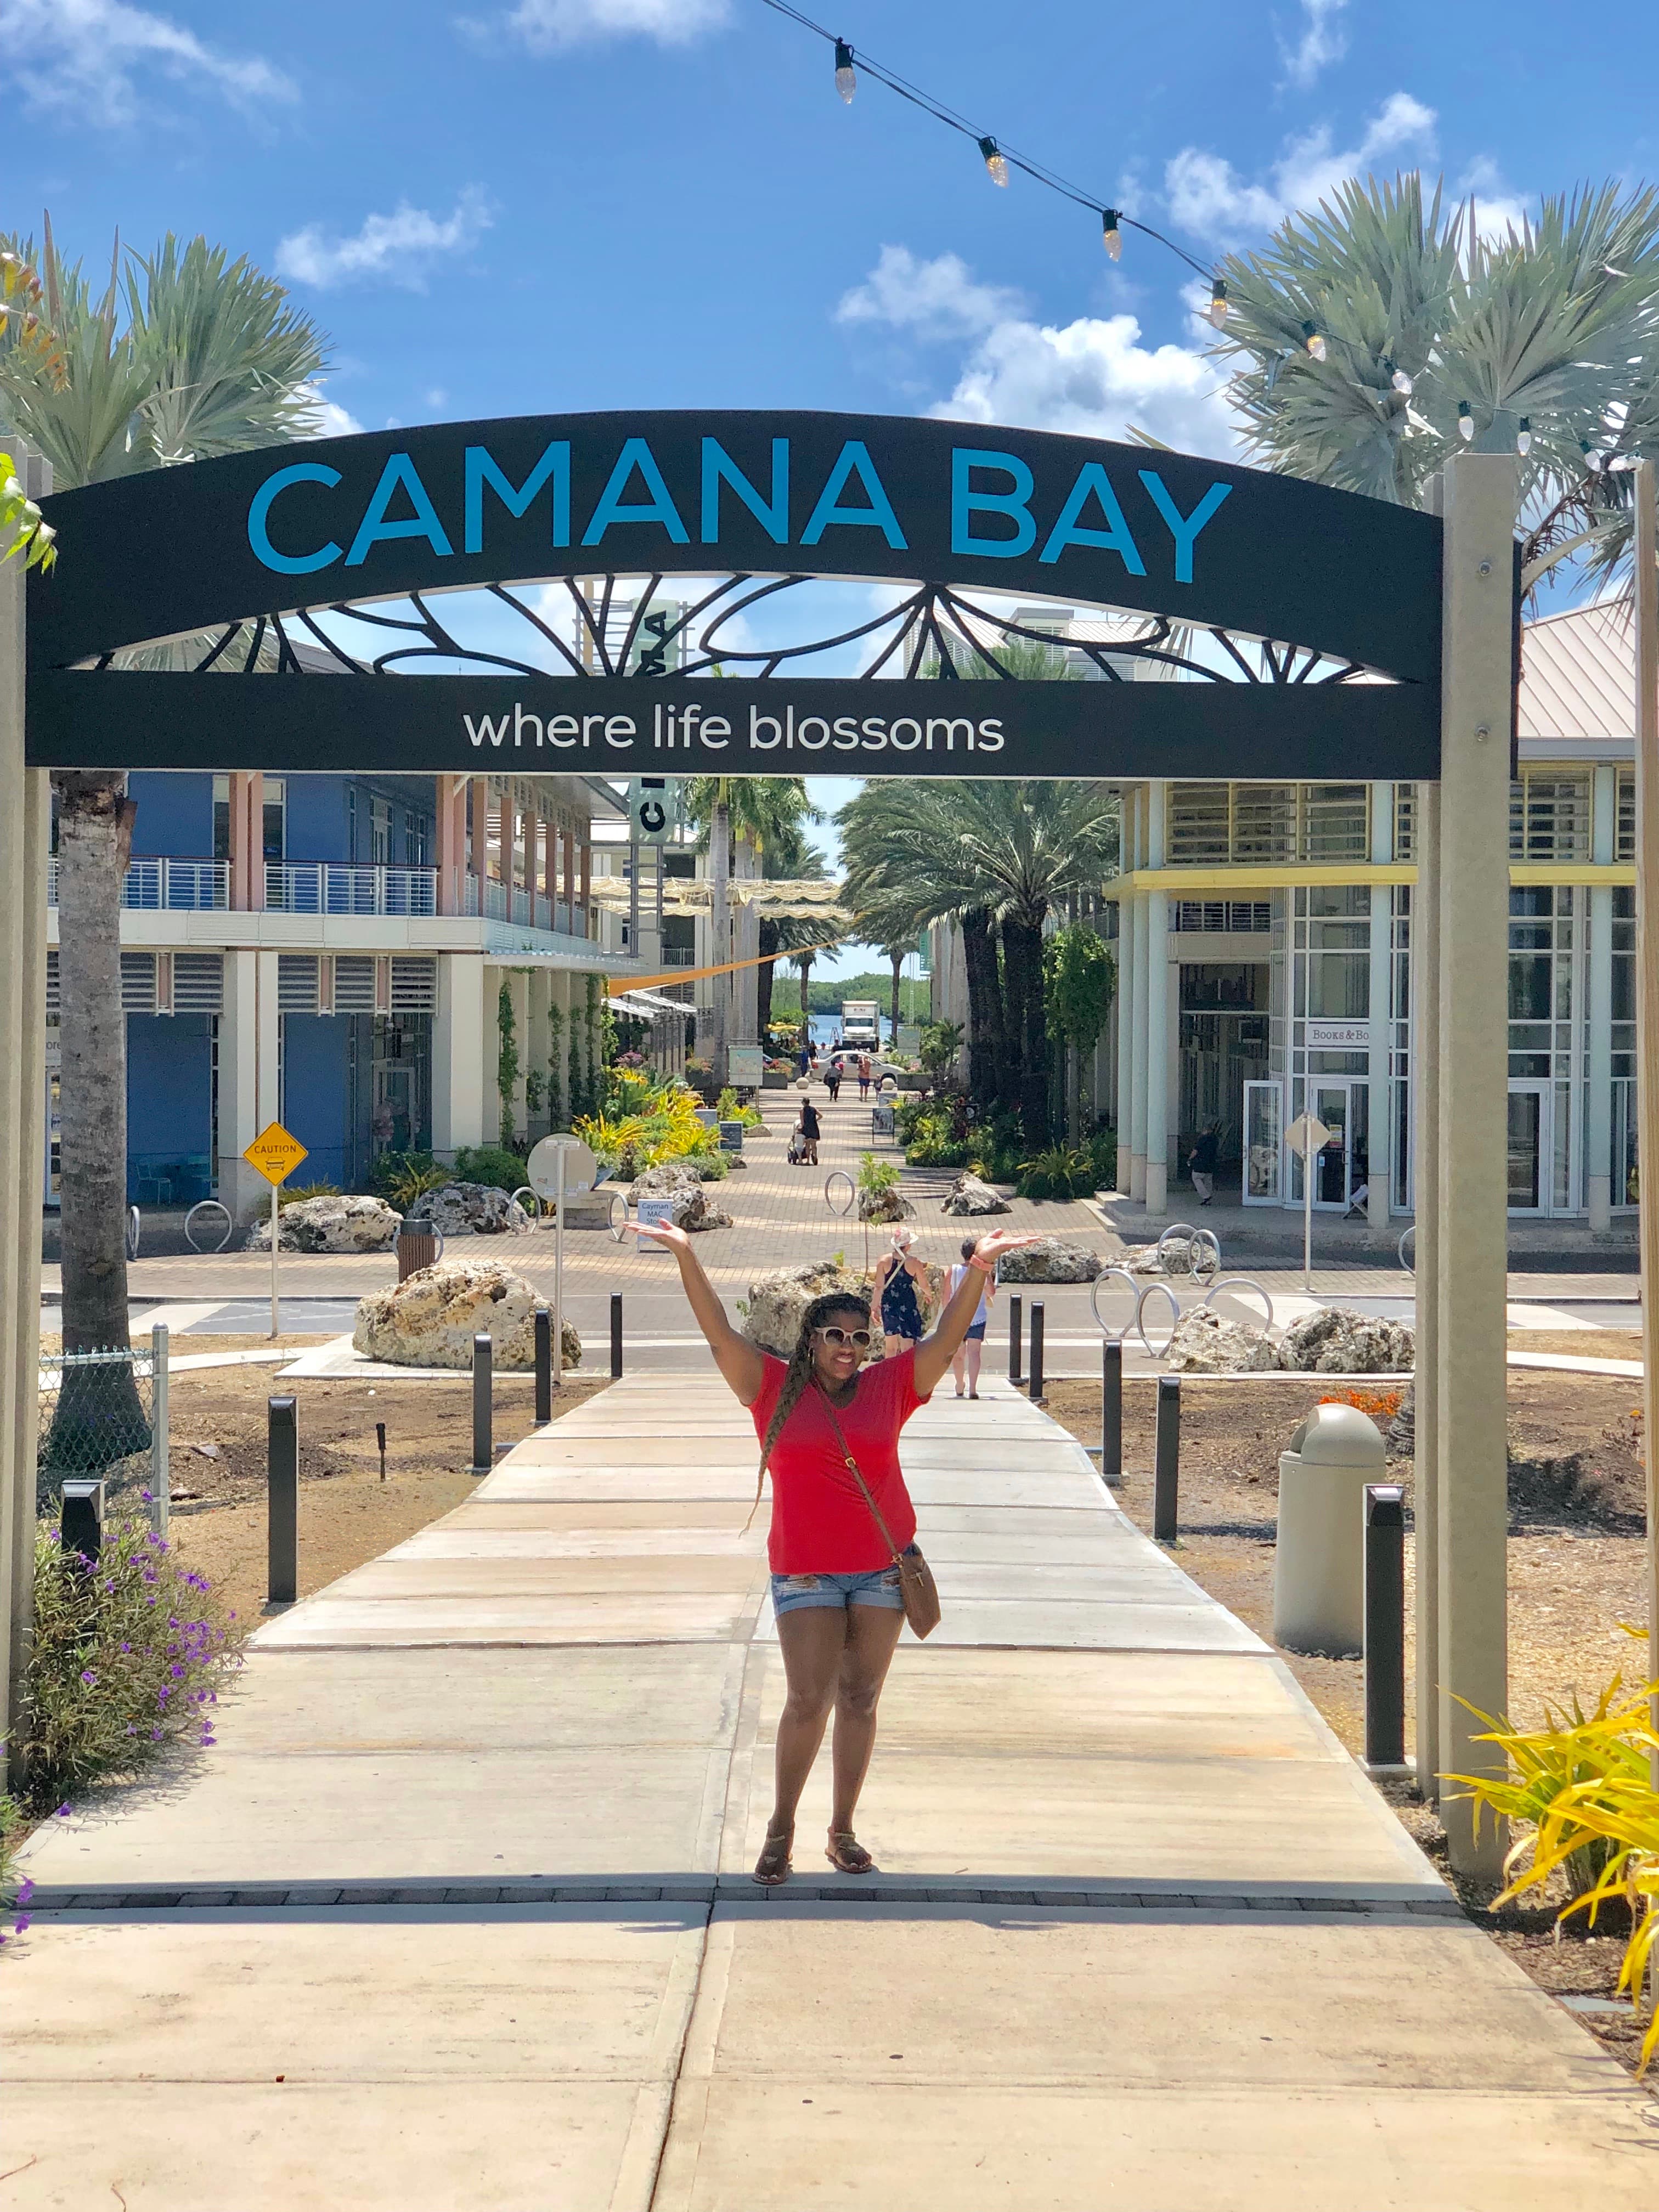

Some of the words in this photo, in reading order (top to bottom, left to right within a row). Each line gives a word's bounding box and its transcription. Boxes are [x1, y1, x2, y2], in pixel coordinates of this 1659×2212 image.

[247, 437, 909, 574] CAMANA
[951, 447, 1233, 584] BAY
[463, 703, 636, 748] where
[654, 704, 731, 749] life
[750, 705, 1005, 751] blossoms
[254, 1145, 297, 1154] CAUTION
